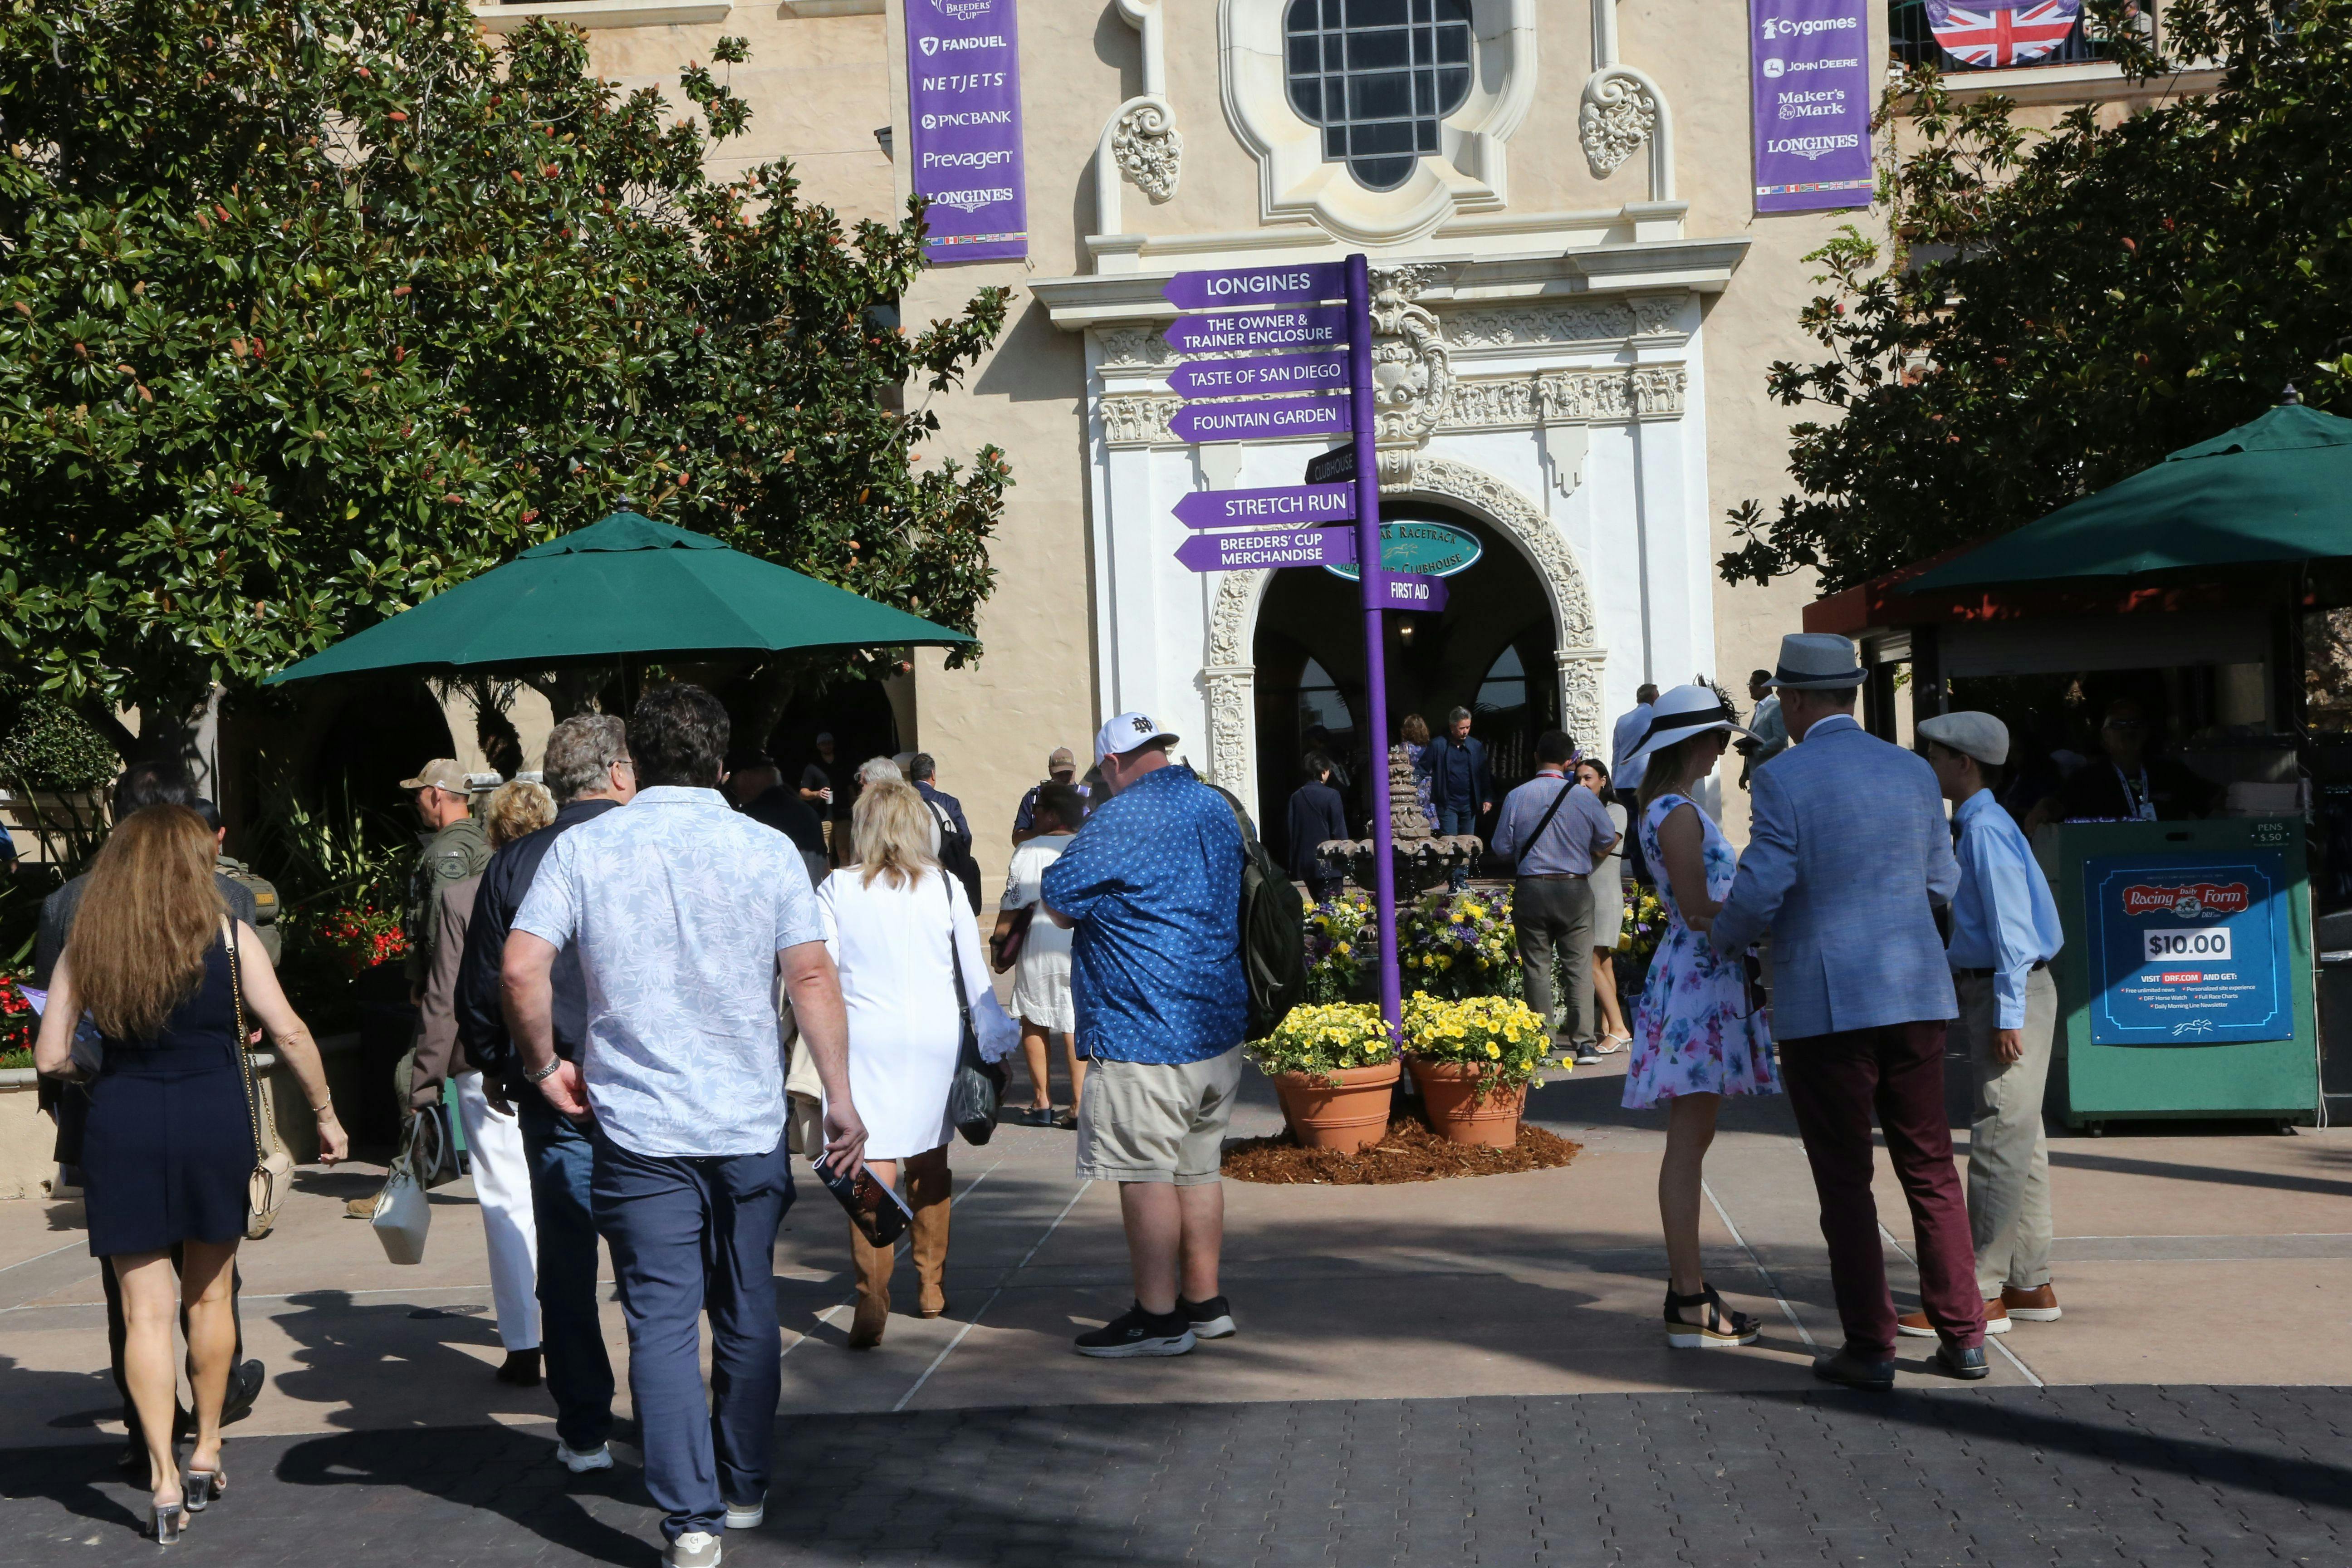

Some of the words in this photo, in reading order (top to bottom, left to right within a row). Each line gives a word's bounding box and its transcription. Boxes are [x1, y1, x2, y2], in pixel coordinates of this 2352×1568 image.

[946, 0, 991, 13] BREEDERS'
[957, 11, 977, 21] CUP
[1779, 17, 1857, 36] Cygames
[942, 36, 1006, 51] FANDUEL
[1787, 61, 1818, 72] JOHN
[1820, 59, 1857, 69] DEERE
[922, 73, 1004, 93] NETJETS
[1778, 89, 1845, 104] Maker's
[938, 113, 970, 127] PNC
[970, 110, 1011, 125] BANK
[1795, 103, 1846, 117] Mark
[1767, 134, 1858, 152] LONGINES
[923, 151, 1010, 170] Prevagen
[926, 188, 1013, 205] LONGINES
[1207, 273, 1311, 295] LONGINES
[1207, 318, 1235, 332] THE
[1239, 314, 1294, 329] OWNER
[1298, 314, 1308, 325] &
[1183, 333, 1245, 348] TRAINER
[1249, 327, 1333, 344] ENCLOSURE
[1189, 371, 1232, 386] TASTE
[1236, 370, 1255, 383] OF
[1260, 367, 1289, 382] SAN
[1294, 363, 1341, 379] DIEGO
[1193, 412, 1270, 431] FOUNTAIN
[1274, 408, 1336, 424] GARDEN
[1315, 454, 1352, 481] CLUBHOUSE
[1225, 496, 1304, 516] STRETCH
[1308, 493, 1346, 511] RUN
[1220, 535, 1291, 550] BREEDERS'
[1295, 534, 1323, 546] CUP
[1380, 529, 1392, 540] AR
[1400, 526, 1457, 544] RACETRACK
[1221, 548, 1323, 565] MERCHANDISE
[1402, 554, 1462, 574] CLUBHOUSE
[1391, 582, 1413, 599] FIRST
[1415, 584, 1429, 600] AID
[2258, 823, 2283, 831] PENS
[2260, 833, 2281, 842] $.50
[2130, 891, 2174, 906] Racing
[2204, 890, 2240, 902] Form
[2149, 934, 2226, 956] $10.00
